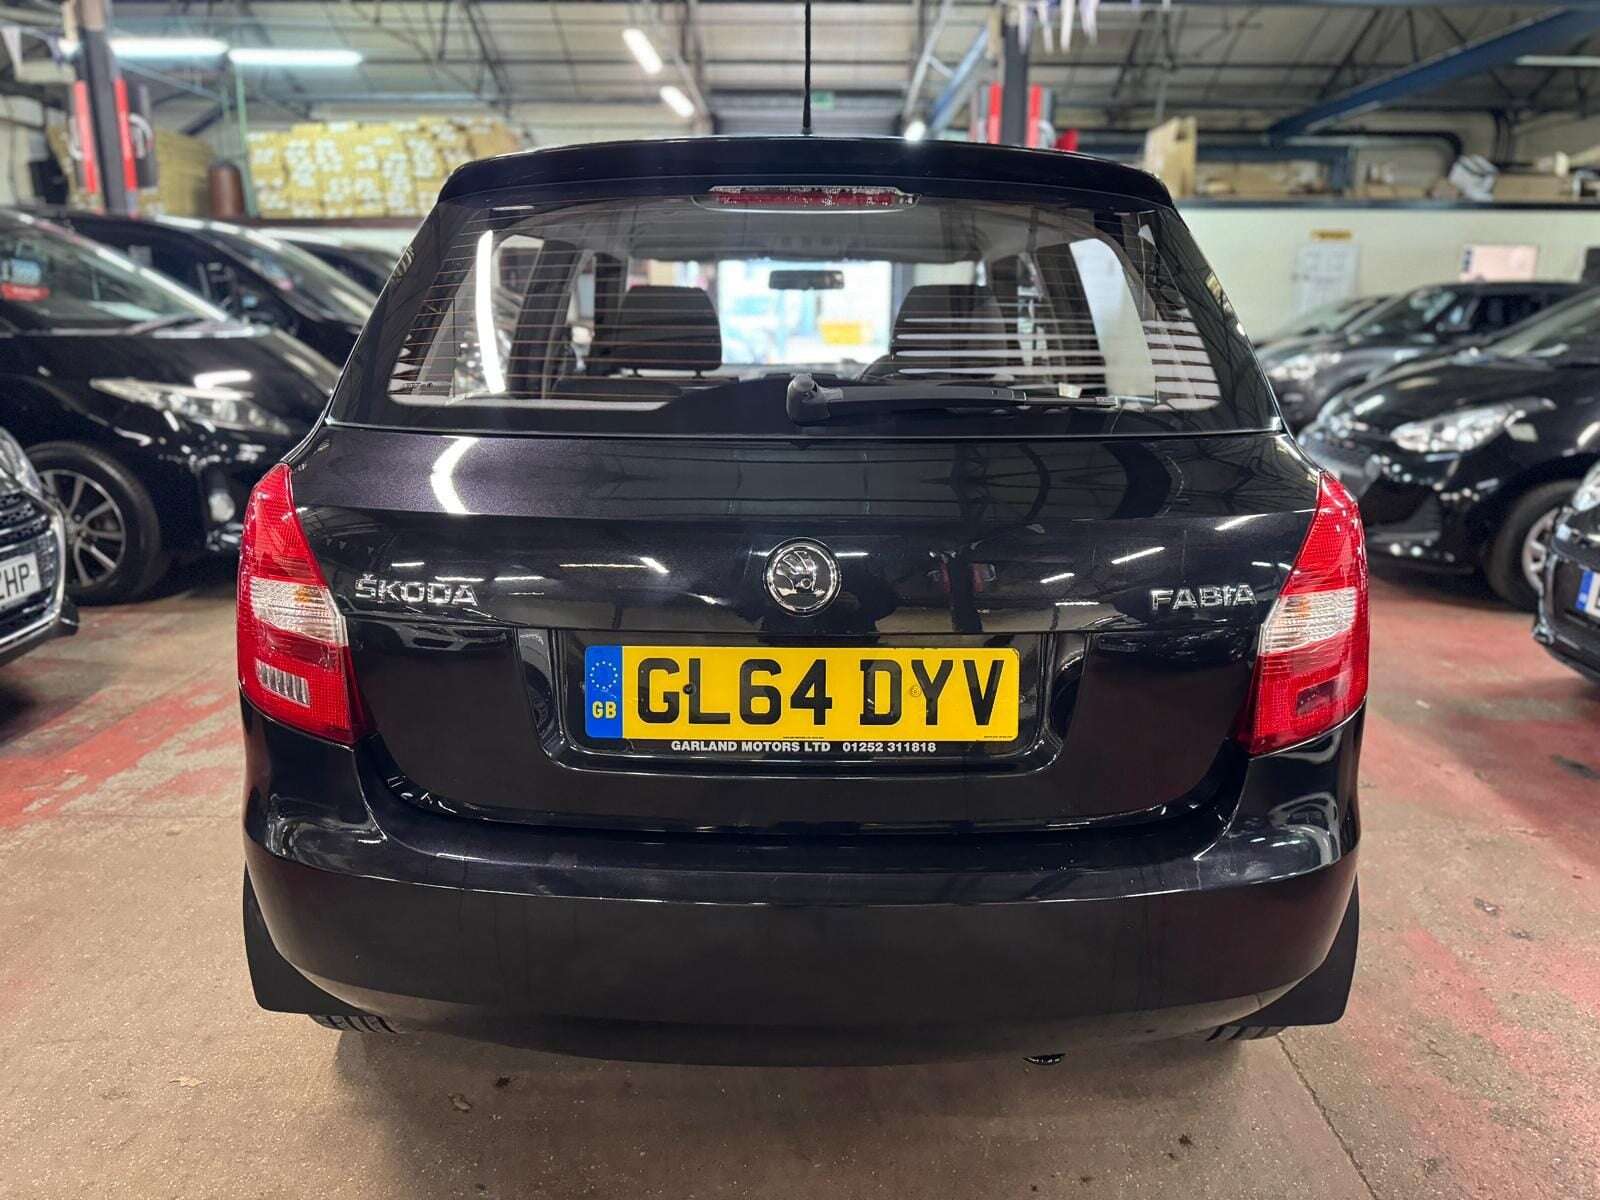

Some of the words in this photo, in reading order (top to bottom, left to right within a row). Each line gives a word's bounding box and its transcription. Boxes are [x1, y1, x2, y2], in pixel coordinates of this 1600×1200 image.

[0, 563, 30, 599] HP
[1150, 584, 1257, 611] FABIA
[637, 657, 832, 725] GL64
[860, 659, 1005, 727] DYV
[592, 701, 617, 719] GB
[671, 740, 738, 752] GARLAND
[741, 740, 801, 753] MOTORS
[804, 741, 831, 753] LTD
[842, 742, 884, 753] 01252
[887, 742, 937, 754] 311818
